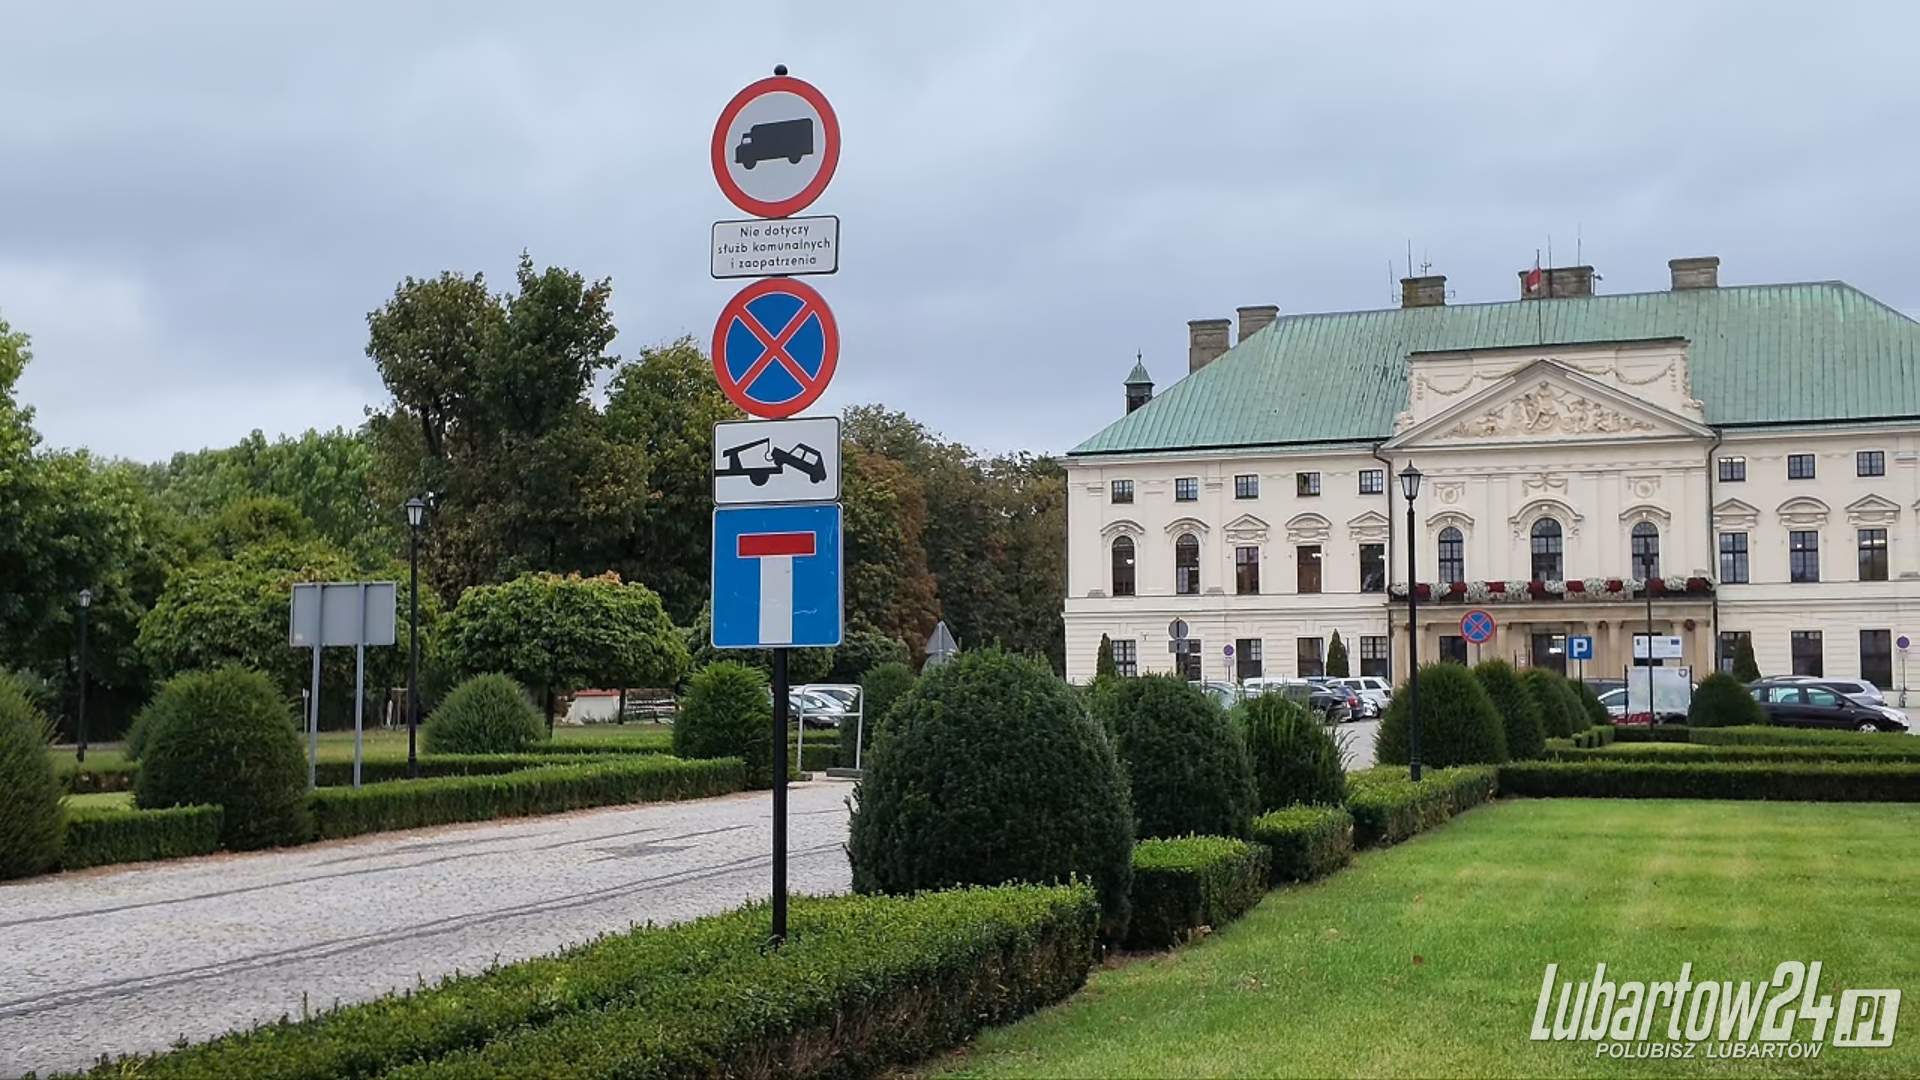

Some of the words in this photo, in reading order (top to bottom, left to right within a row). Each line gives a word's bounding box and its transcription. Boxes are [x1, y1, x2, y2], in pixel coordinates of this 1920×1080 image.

[740, 226, 760, 237] Nie
[764, 225, 810, 238] dotyczy
[717, 242, 748, 254] służb
[752, 237, 831, 252] komunalnych
[739, 254, 817, 270] zaopatrzenia
[1573, 638, 1588, 657] P
